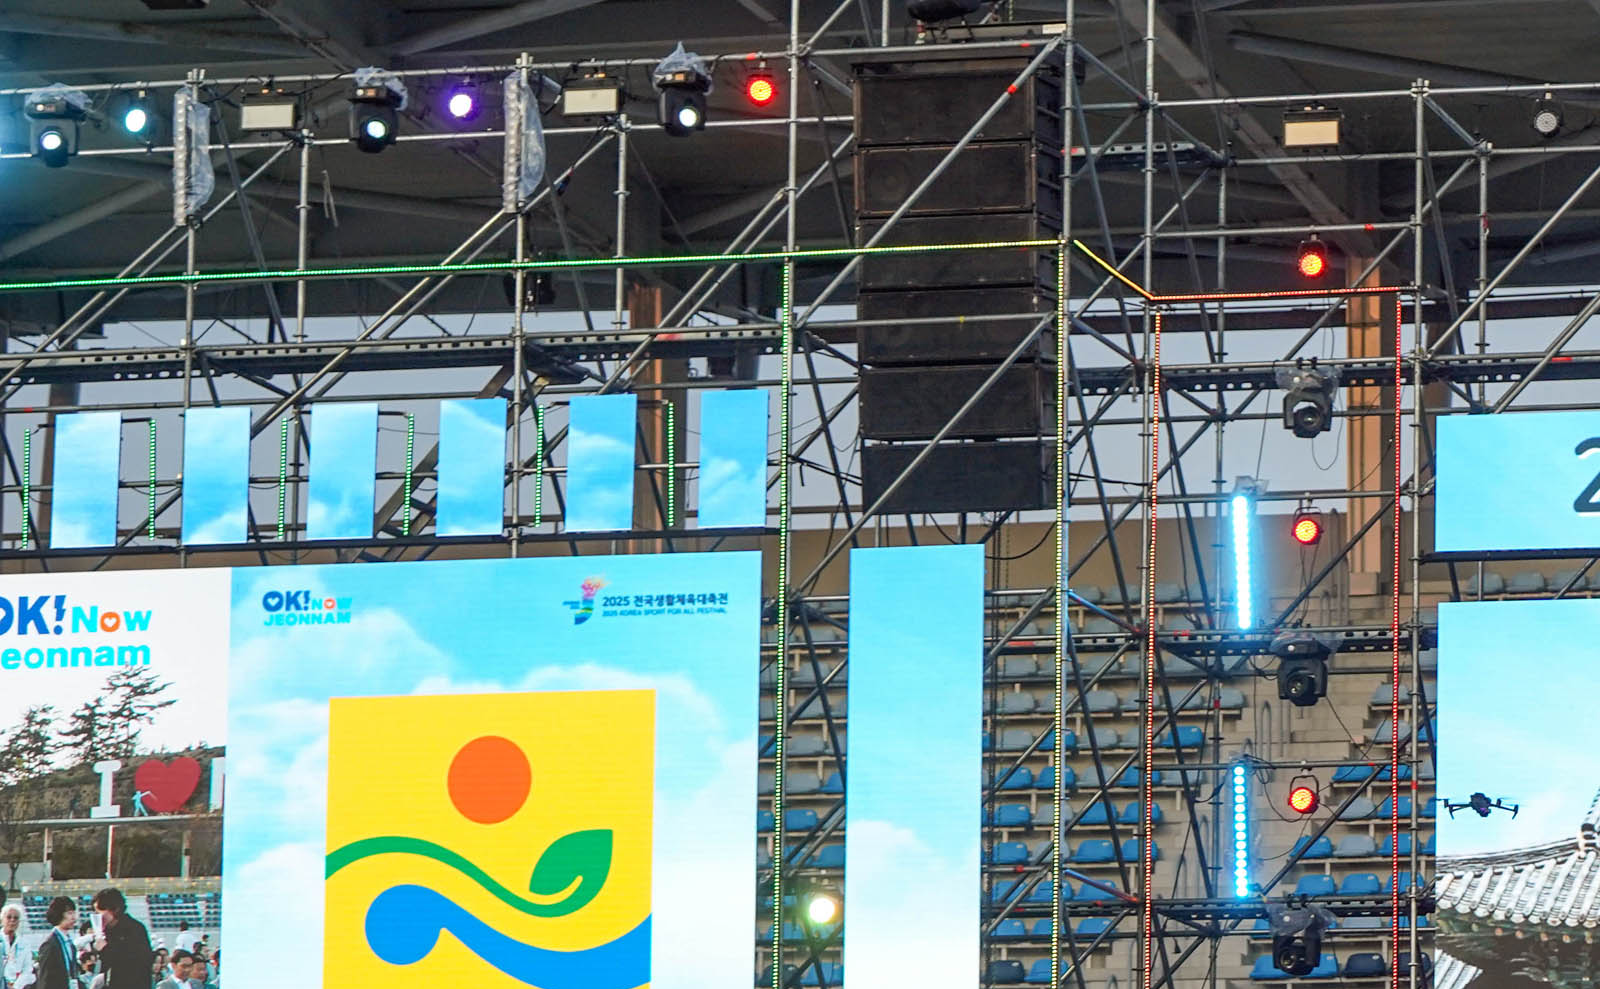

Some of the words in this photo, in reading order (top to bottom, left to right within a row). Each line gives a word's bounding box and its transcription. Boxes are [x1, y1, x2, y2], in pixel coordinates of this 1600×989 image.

[262, 590, 311, 612] OK!
[602, 596, 630, 607] 2025
[0, 644, 151, 670] eonnam
